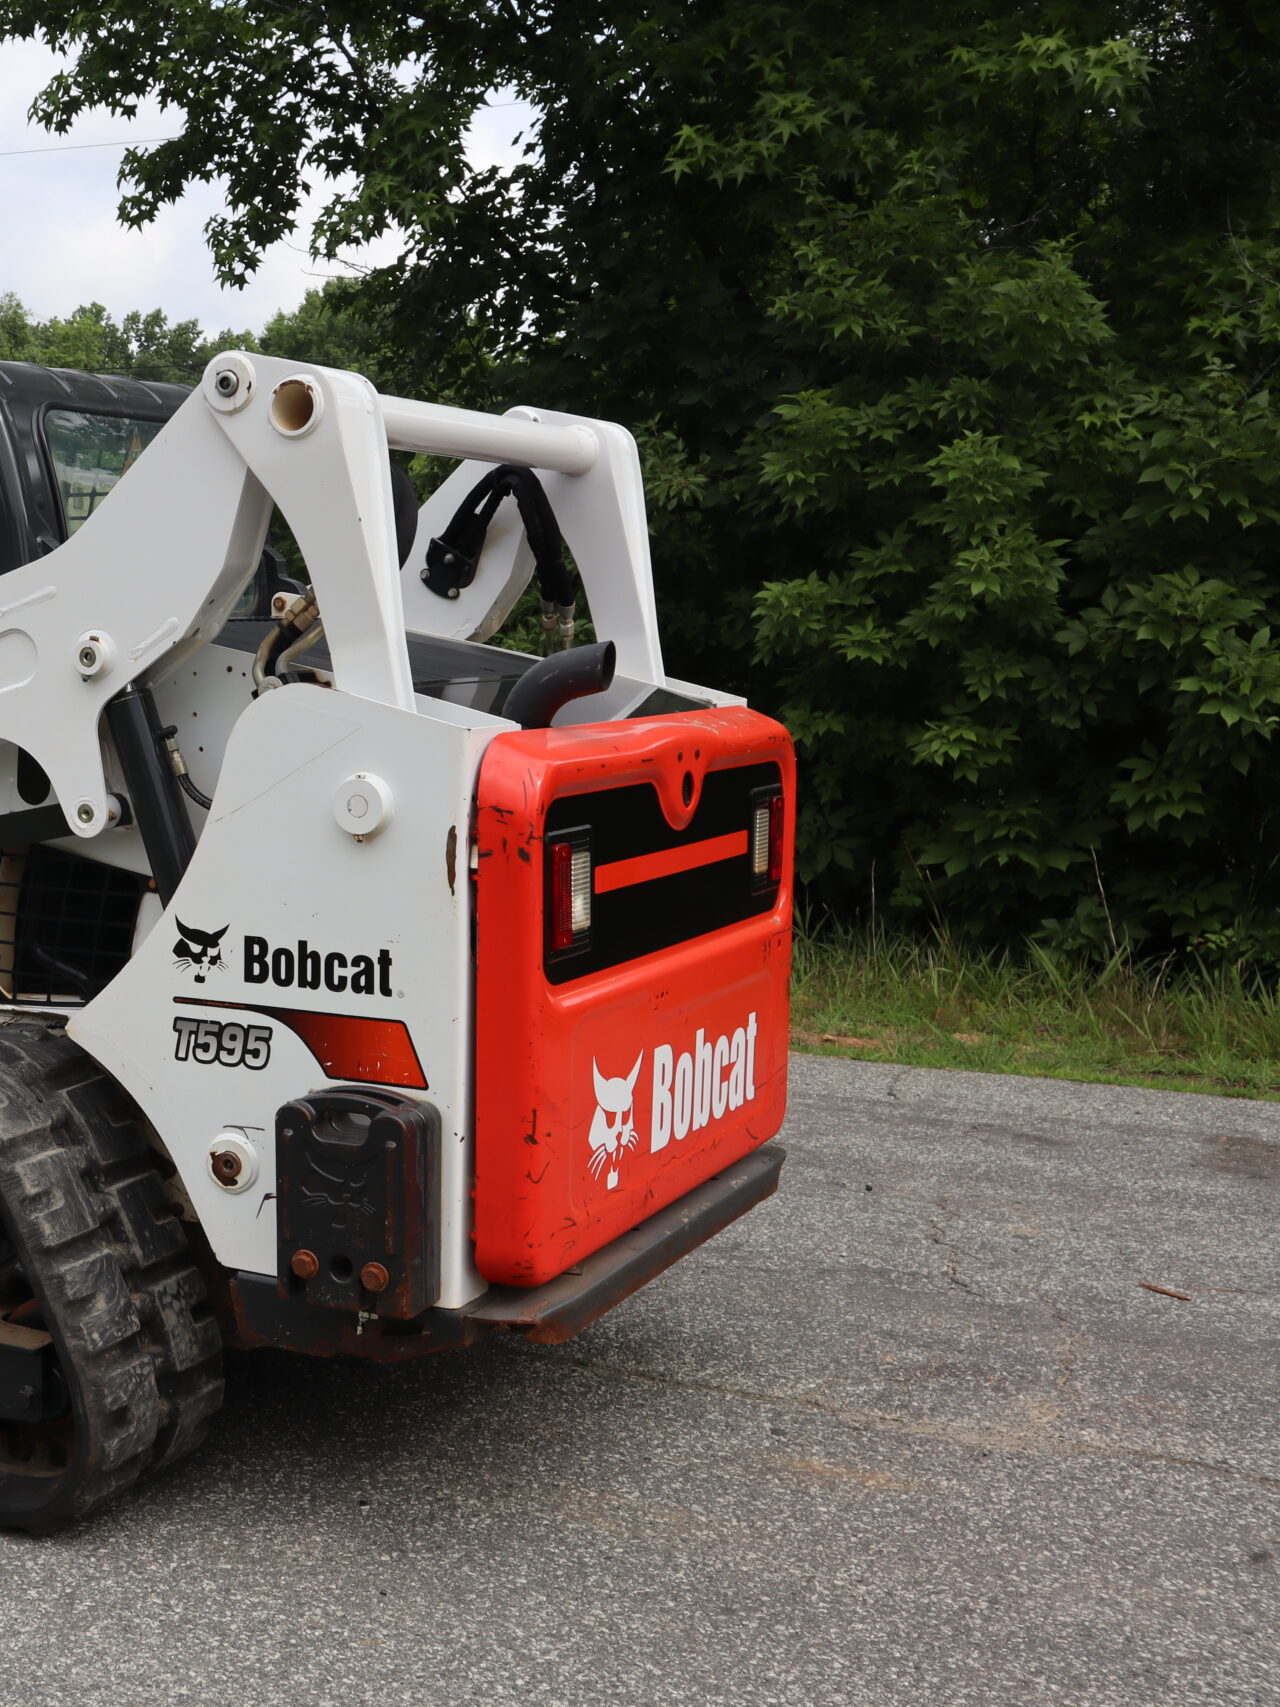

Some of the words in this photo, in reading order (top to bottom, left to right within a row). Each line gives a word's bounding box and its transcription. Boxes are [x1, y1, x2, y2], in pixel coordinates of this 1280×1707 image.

[243, 935, 393, 997] Bobcat
[173, 1016, 273, 1071] T595
[650, 1011, 758, 1154] Bobcat
